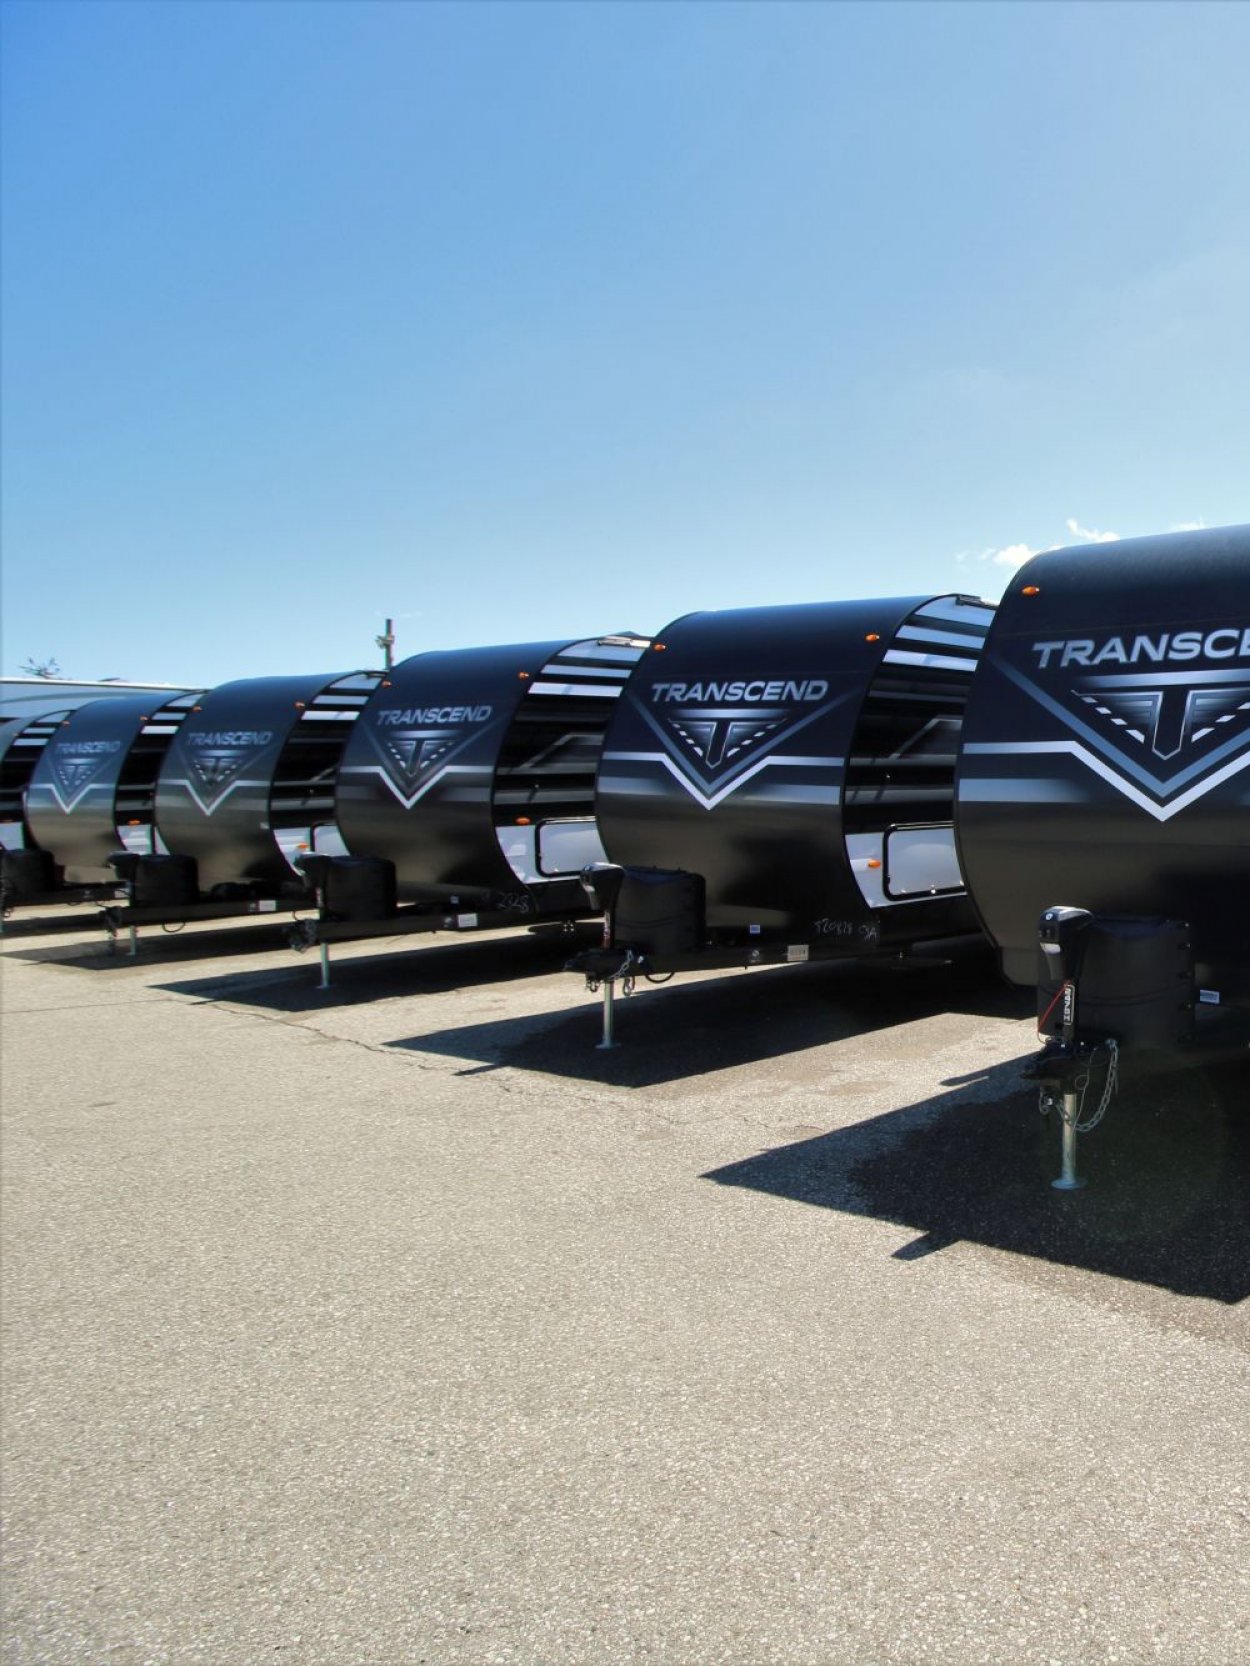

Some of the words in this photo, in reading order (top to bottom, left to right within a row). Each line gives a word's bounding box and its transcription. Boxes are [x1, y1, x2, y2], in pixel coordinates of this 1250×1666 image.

[650, 680, 829, 702] TRANSCEND
[377, 705, 492, 726] TRANSCEND
[57, 740, 121, 754] TRANSCEND
[187, 731, 273, 746] TRANSCEND
